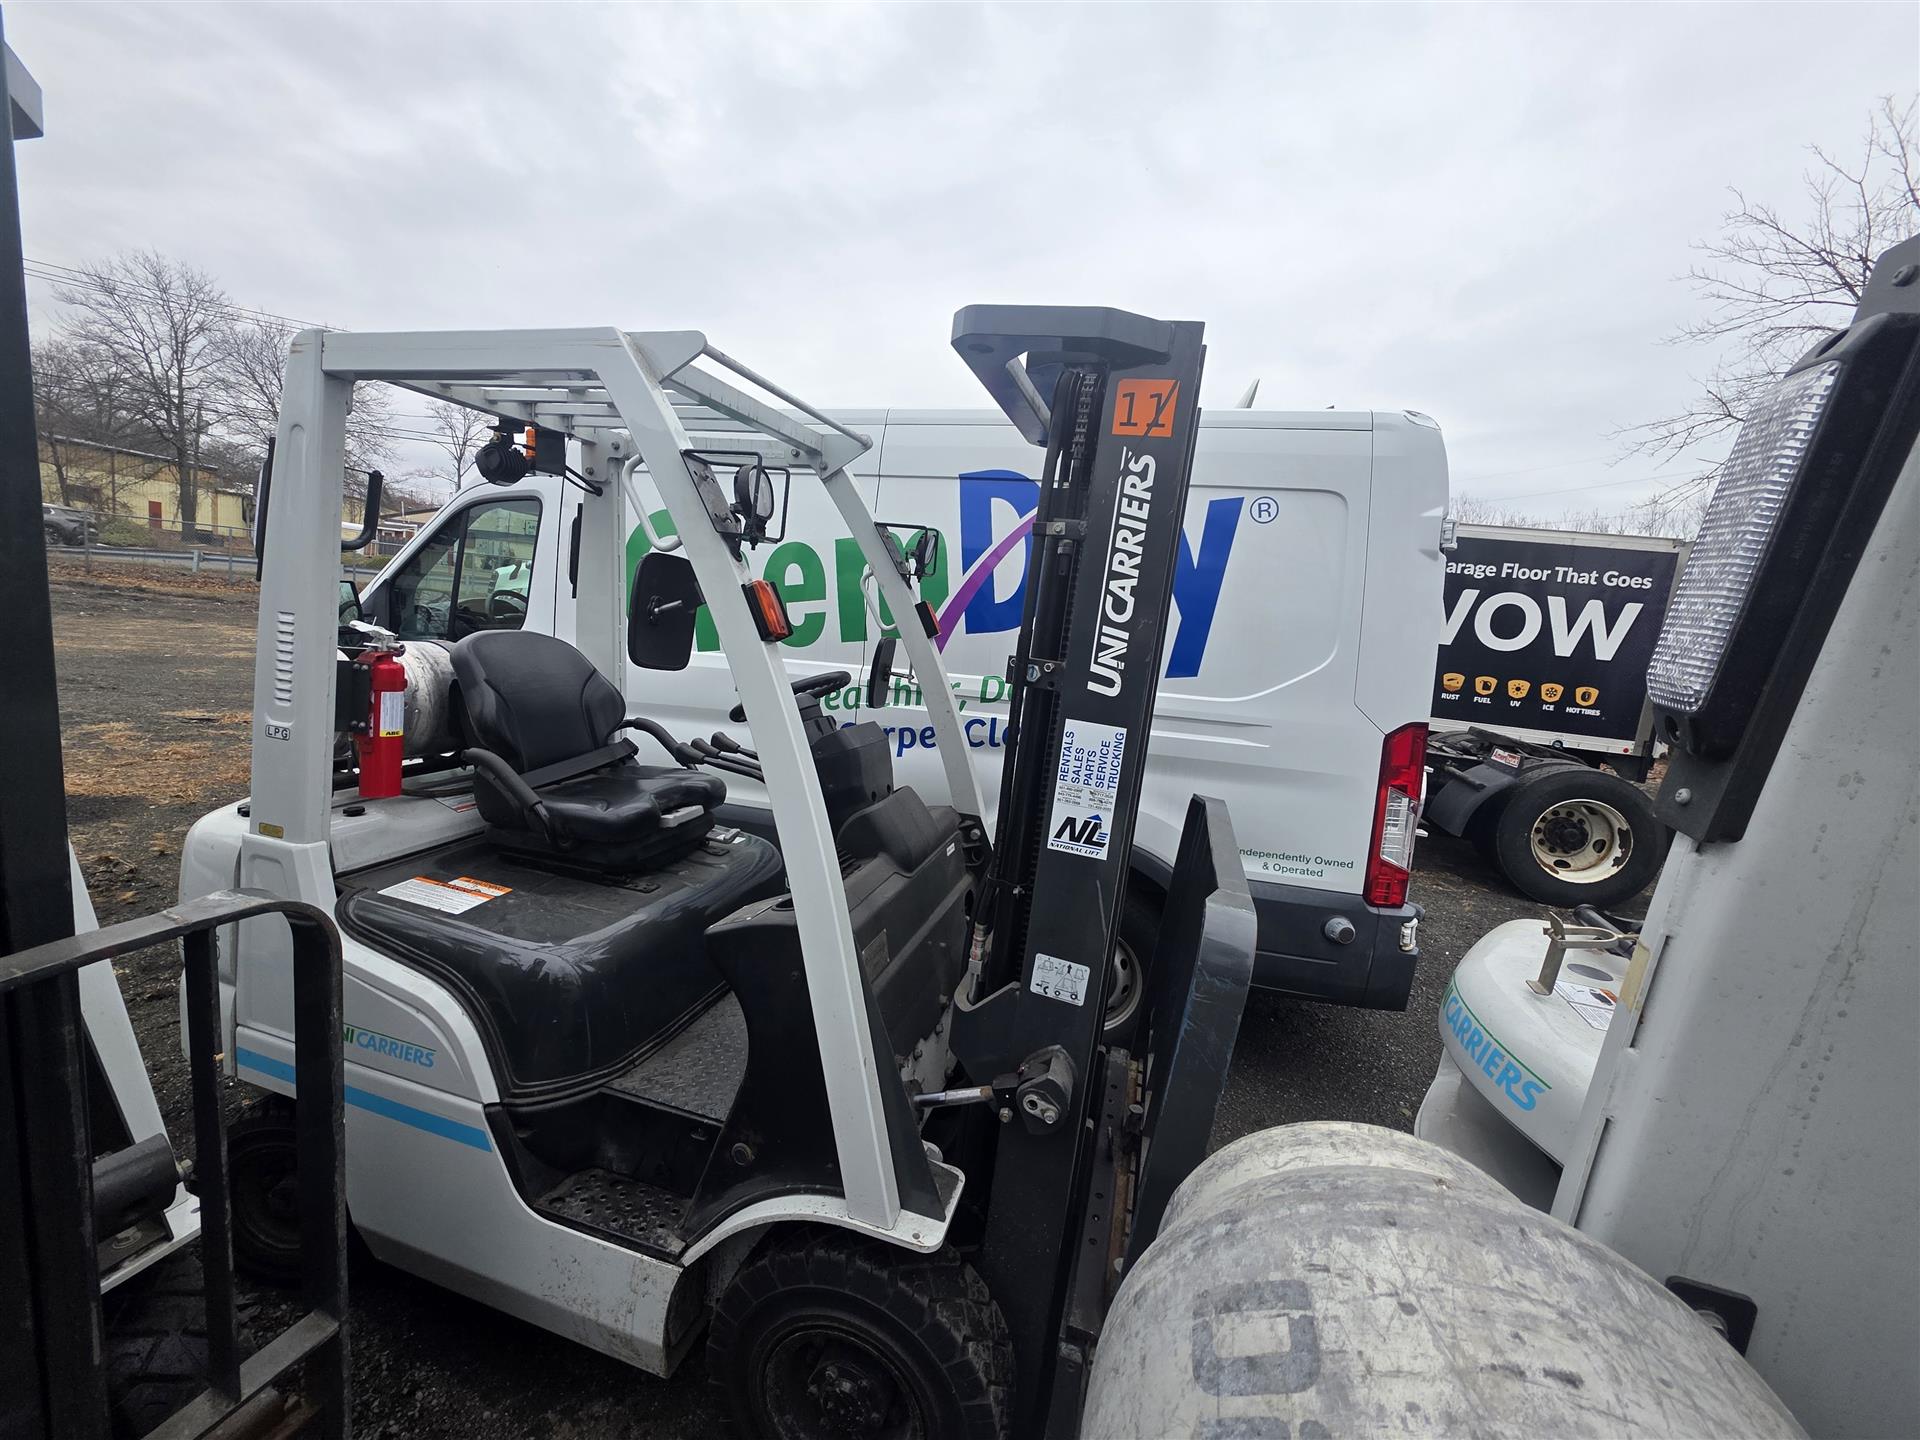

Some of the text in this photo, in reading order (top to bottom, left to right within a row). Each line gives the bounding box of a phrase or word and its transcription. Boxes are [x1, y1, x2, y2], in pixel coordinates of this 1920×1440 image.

[1118, 391, 1166, 428] 11
[1446, 561, 1653, 589] arage Floor That Goes
[1441, 692, 1460, 701] RUST
[1473, 696, 1491, 704] FUEL
[1510, 700, 1521, 708] UV
[267, 726, 289, 740] LPG
[1059, 730, 1075, 782] RENTALS
[1070, 747, 1085, 785] SALES
[1082, 749, 1097, 787] PARTS
[1094, 740, 1111, 789] SERVICE
[1107, 731, 1124, 790] TRUCKING
[1050, 842, 1101, 857] NATIONAL LIFT
[1238, 848, 1354, 869] ndependently Owned
[1262, 861, 1324, 878] & Operated
